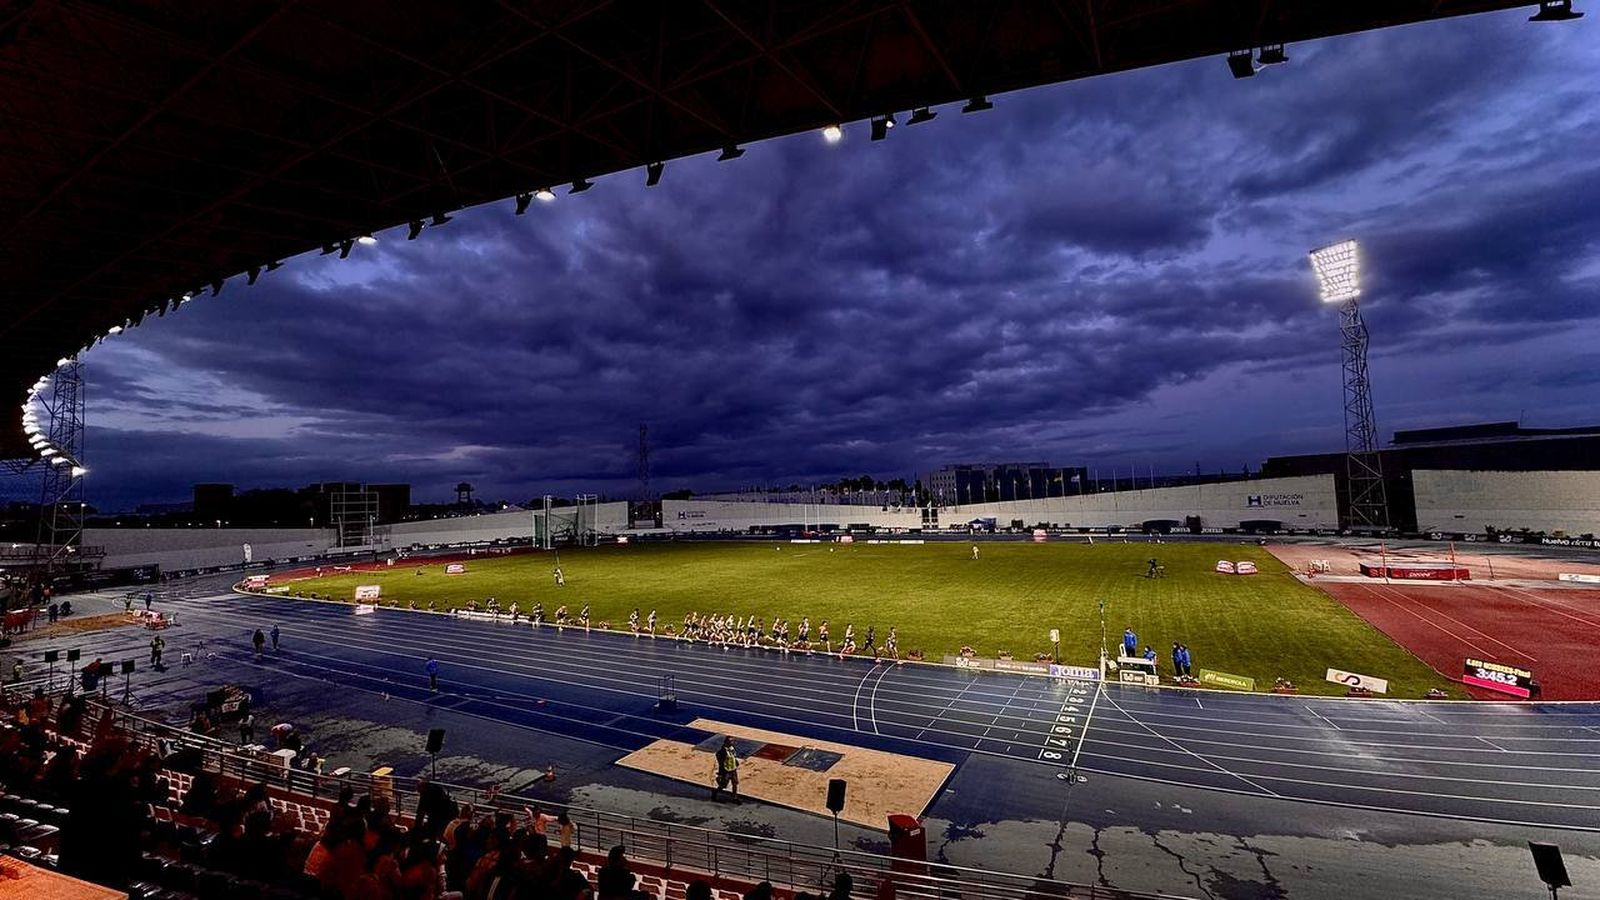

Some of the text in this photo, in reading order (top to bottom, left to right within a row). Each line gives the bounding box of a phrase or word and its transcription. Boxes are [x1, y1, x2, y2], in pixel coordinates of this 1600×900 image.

[1541, 538, 1570, 546] Huelva
[1476, 668, 1518, 686] 3:45.2
[1055, 726, 1072, 734] 6
[1043, 751, 1062, 759] 8
